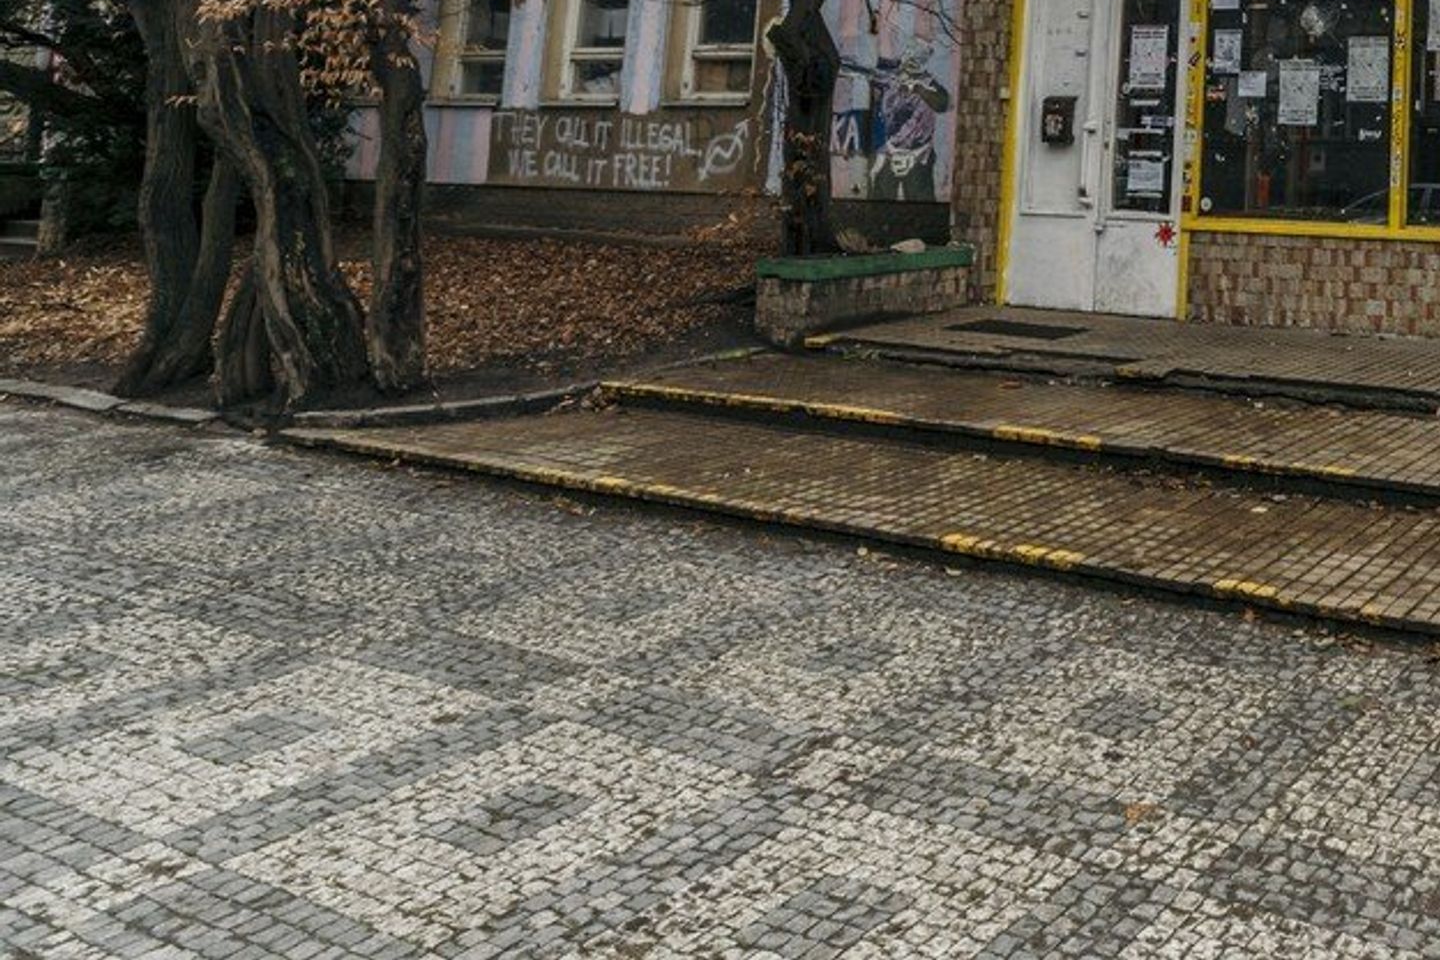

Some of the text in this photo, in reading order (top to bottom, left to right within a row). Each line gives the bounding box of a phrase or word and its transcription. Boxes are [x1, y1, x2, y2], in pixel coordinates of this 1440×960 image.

[492, 111, 548, 150] THEY
[555, 116, 590, 148] CALL
[595, 121, 612, 151] IT
[508, 148, 672, 187] WE CALL IT FREE!
